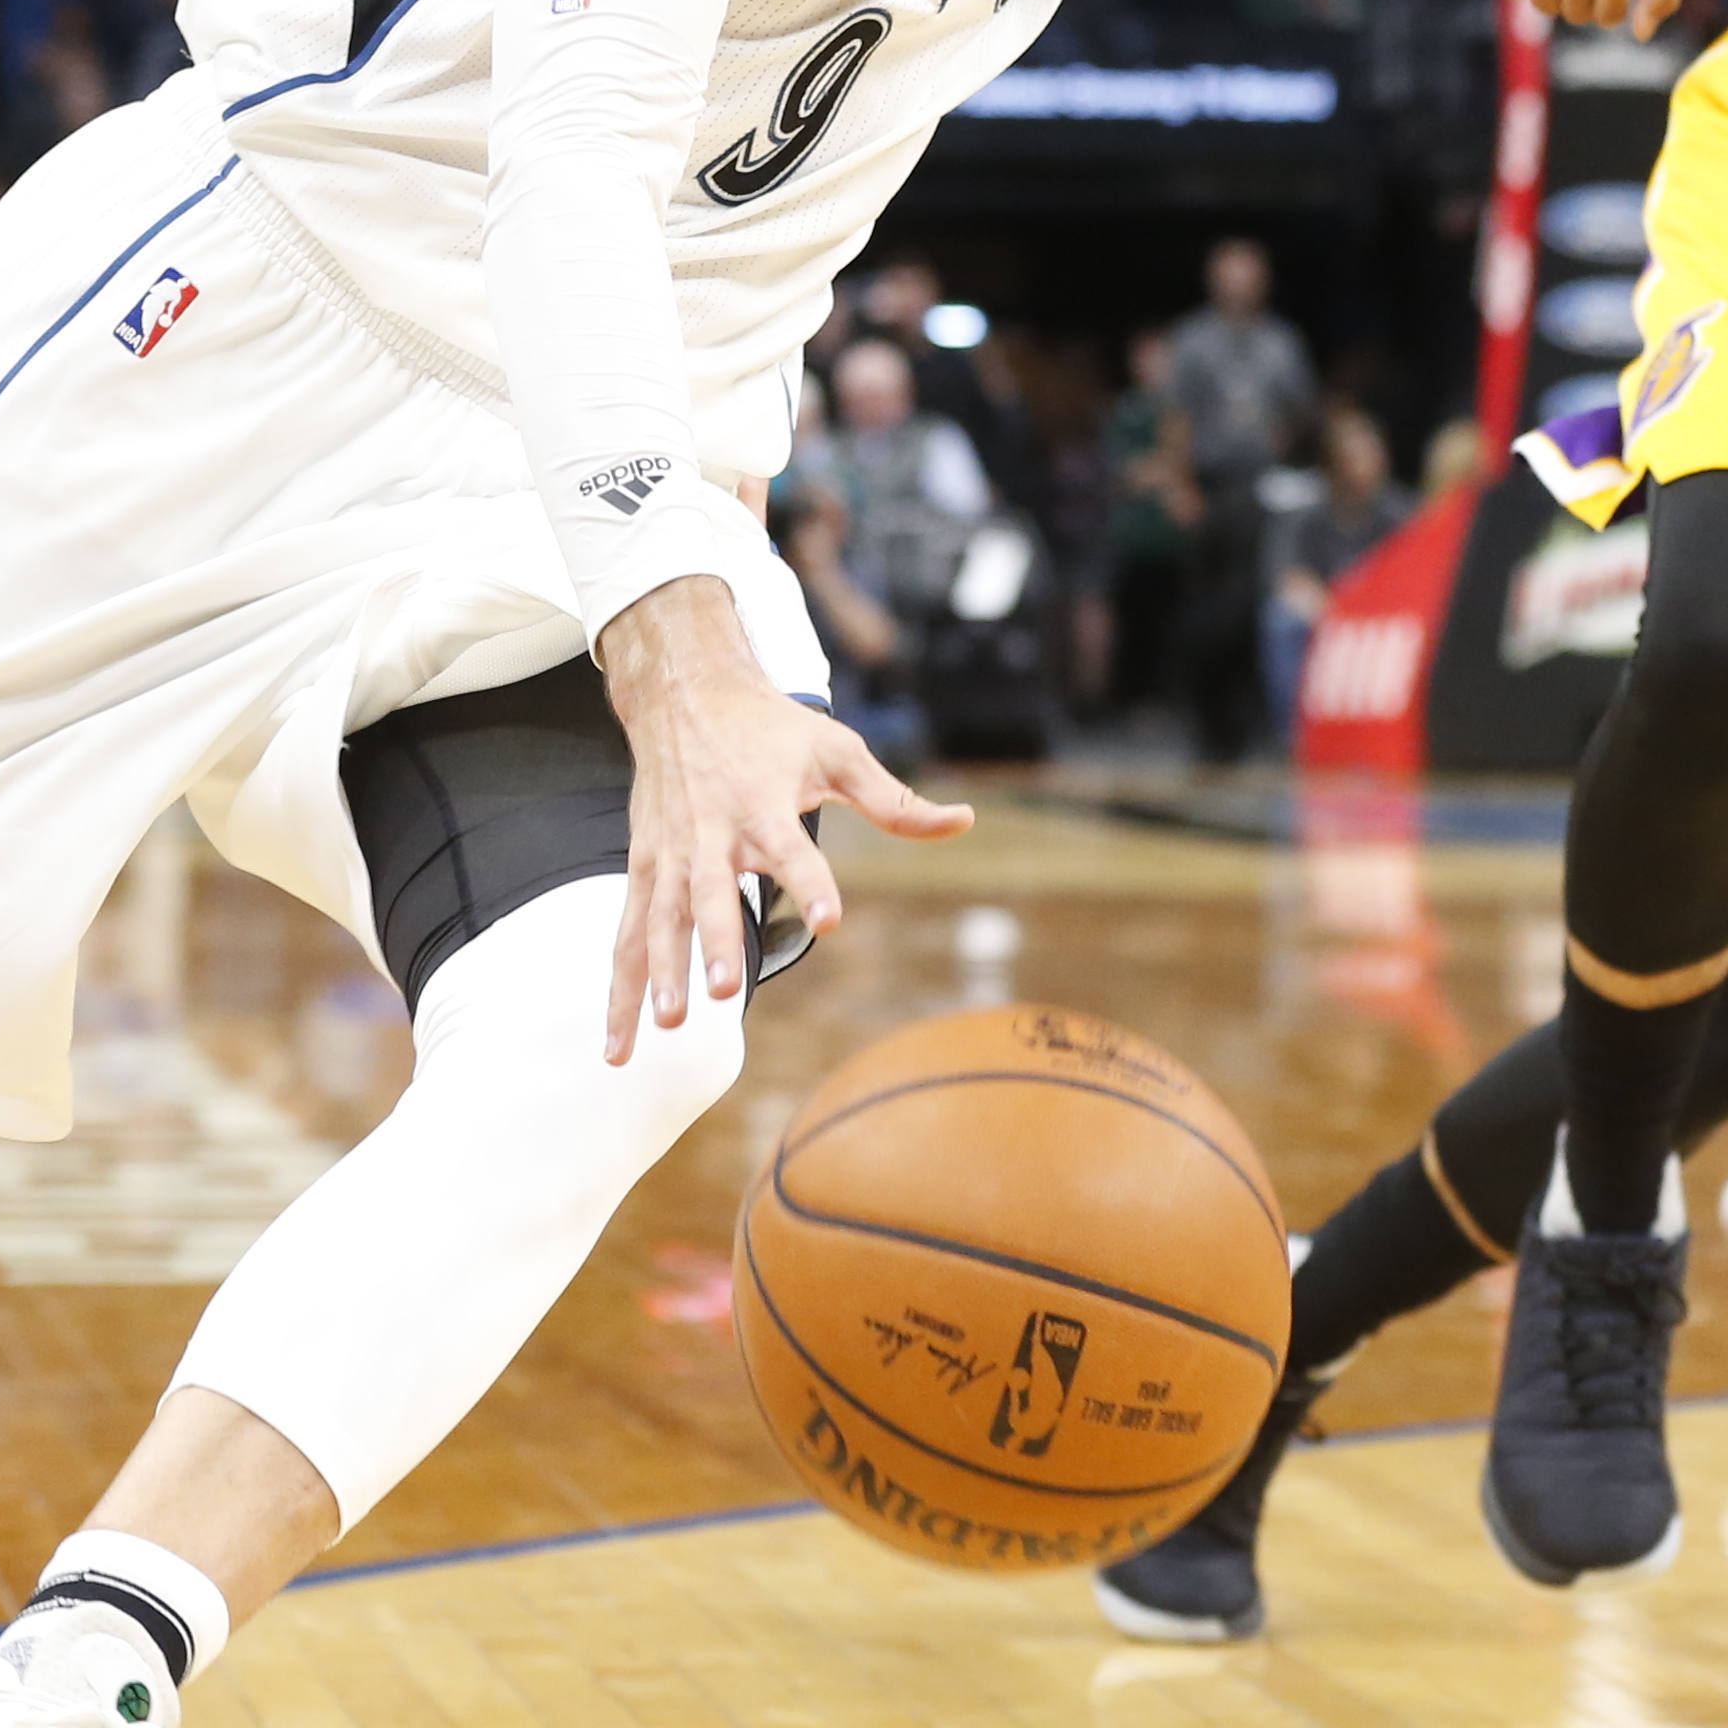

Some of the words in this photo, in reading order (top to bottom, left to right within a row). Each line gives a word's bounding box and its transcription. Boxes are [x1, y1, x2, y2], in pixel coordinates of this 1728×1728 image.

[695, 7, 893, 208] 9
[115, 322, 144, 350] NBA
[578, 456, 672, 498] adidas
